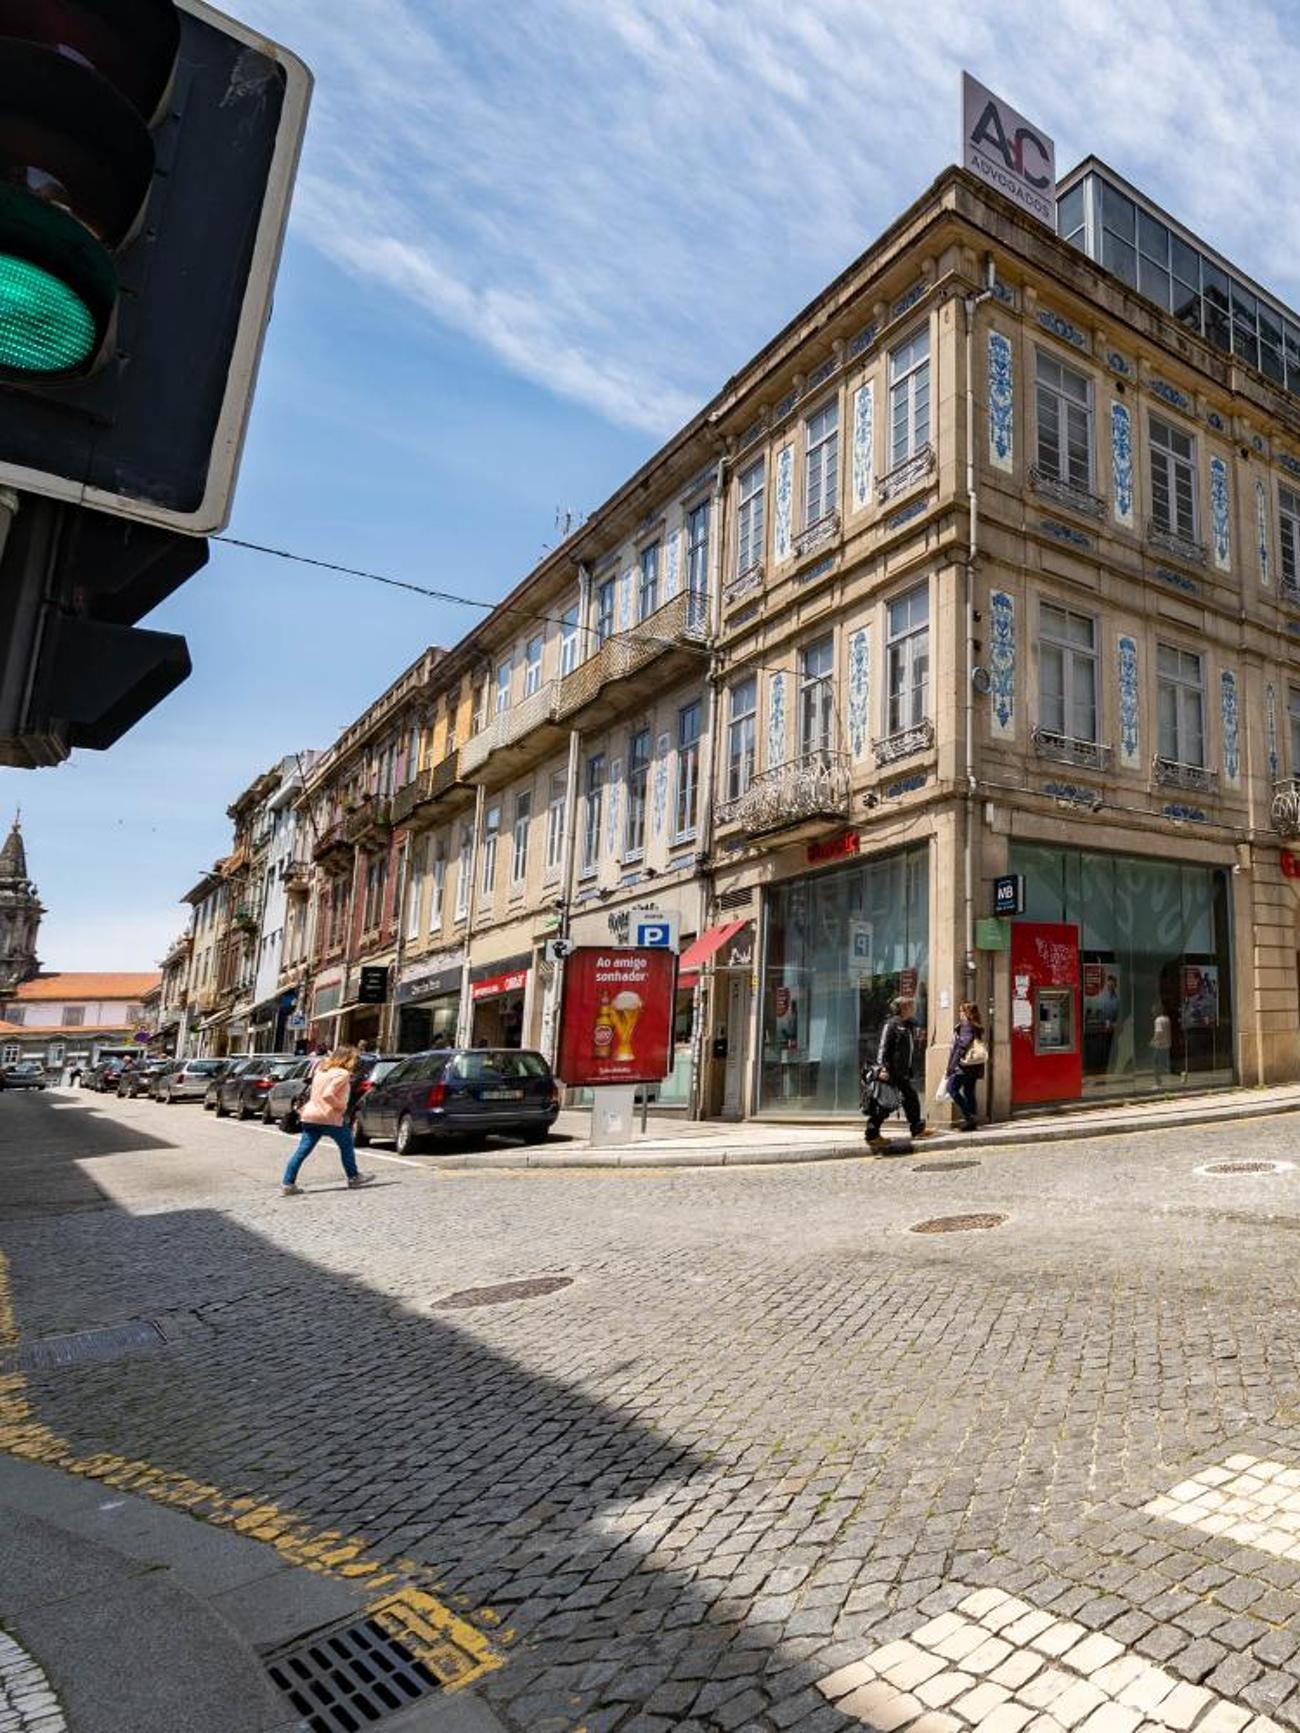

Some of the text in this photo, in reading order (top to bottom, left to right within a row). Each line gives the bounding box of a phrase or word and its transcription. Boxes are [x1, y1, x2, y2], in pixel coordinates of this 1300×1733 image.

[971, 155, 1050, 218] ADVOGADOS
[997, 885, 1014, 900] MB
[644, 927, 663, 946] P
[596, 956, 648, 971] Ao amigo
[595, 970, 646, 982] sonhador
